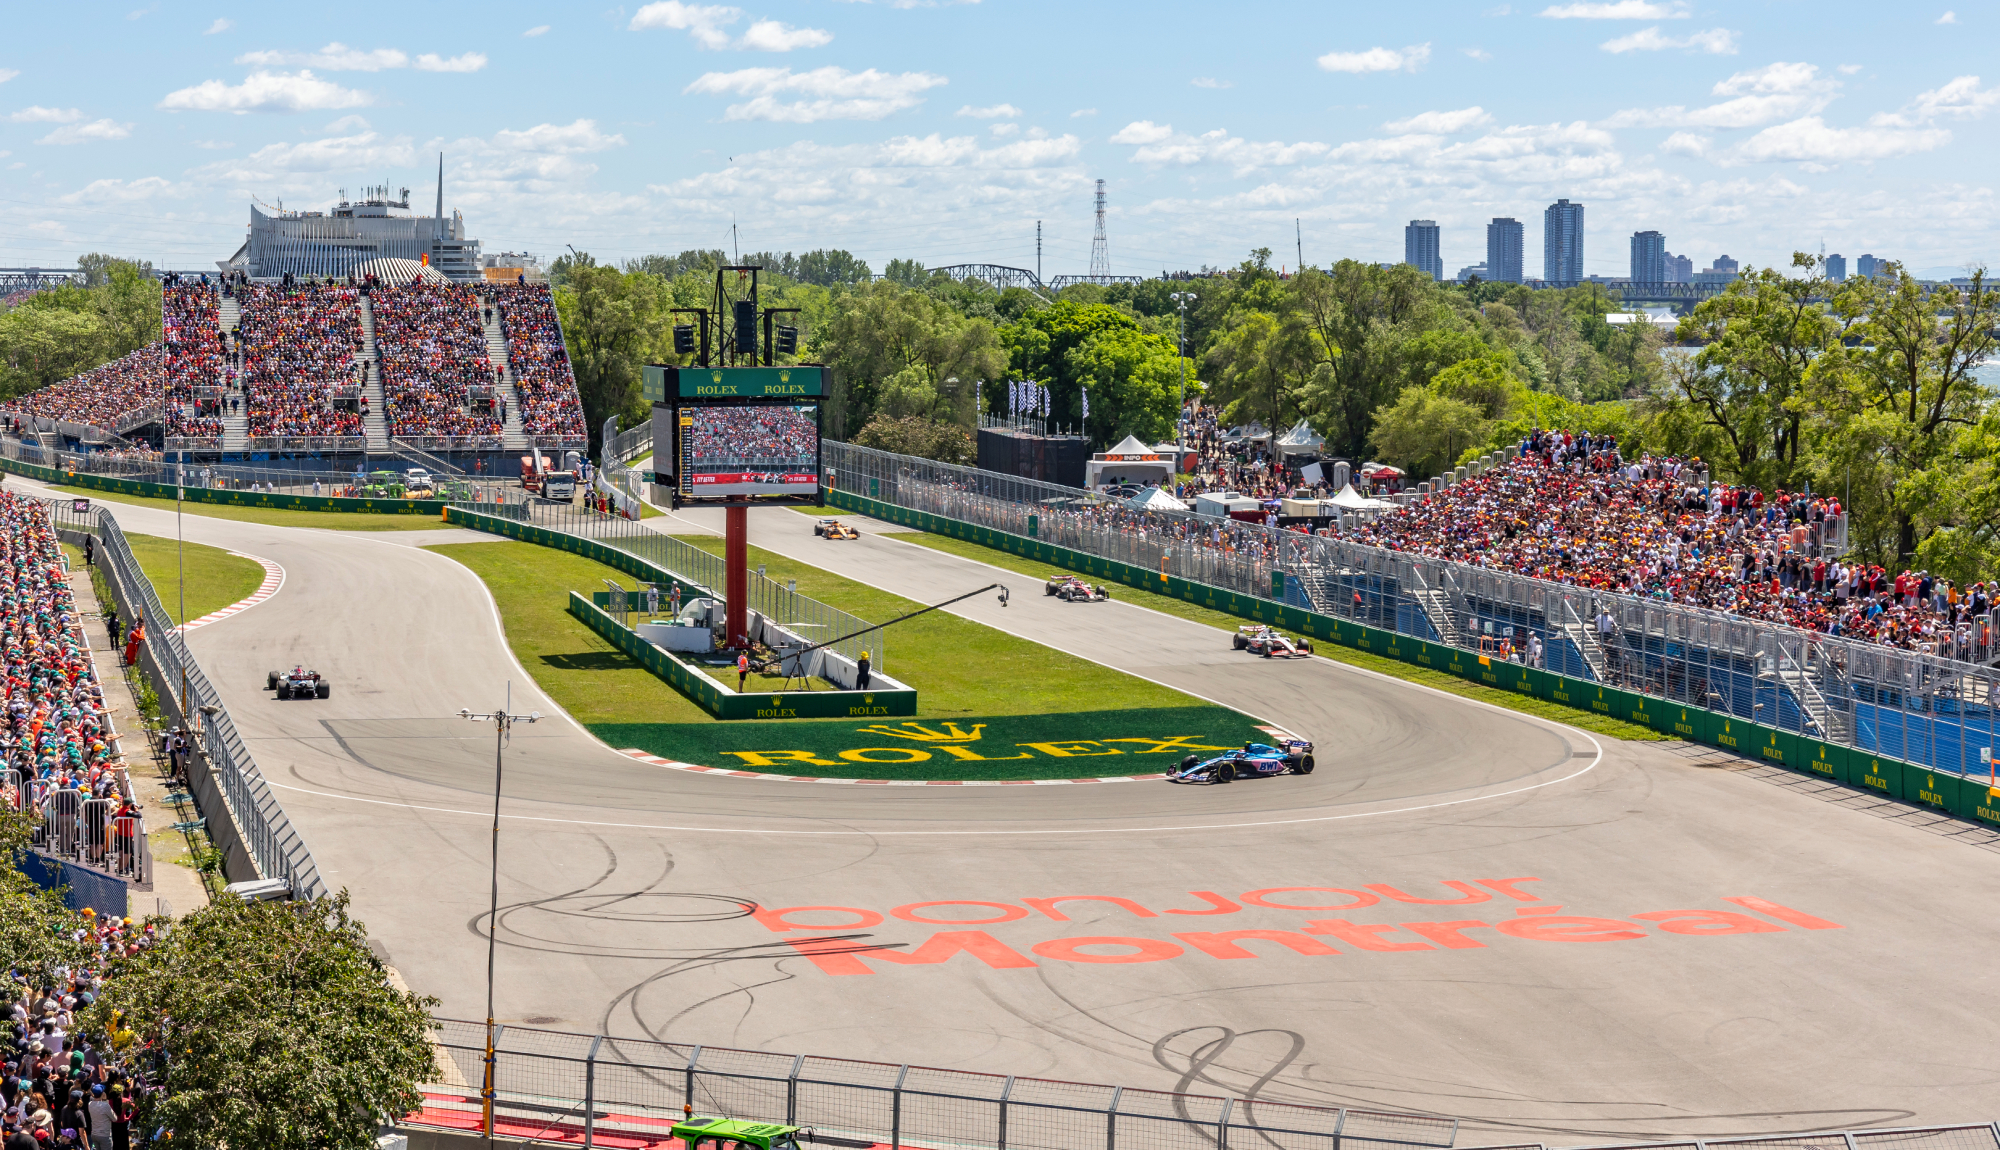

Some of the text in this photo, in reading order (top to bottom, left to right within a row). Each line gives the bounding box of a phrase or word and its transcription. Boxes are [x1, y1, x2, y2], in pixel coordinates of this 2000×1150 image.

[697, 386, 738, 394] ROLEX
[764, 385, 806, 394] ROLEX
[1330, 632, 1342, 641] ROLEX
[1358, 639, 1370, 648] ROLEX
[1388, 646, 1400, 656] ROLEX
[1418, 654, 1432, 664] ROLEX
[1449, 662, 1464, 674] ROLEX
[1482, 672, 1497, 683] ROLEX
[1517, 681, 1532, 692] ROLEX
[1553, 690, 1570, 702] ROLEX
[849, 706, 888, 716] ROLEX
[1592, 700, 1609, 712] ROLEX
[757, 708, 796, 717] ROLEX
[1632, 710, 1650, 724] ROLEX
[1675, 722, 1693, 735] ROLEX
[1718, 734, 1737, 748] ROLEX
[720, 736, 1246, 767] ROLEX
[1763, 746, 1783, 761] ROLEX
[1259, 760, 1278, 770] BWT
[1812, 760, 1834, 775] ROLEX
[1864, 774, 1888, 790] ROLEX
[1919, 789, 1943, 806] ROLEX
[1977, 806, 2000, 822] ROLEX
[736, 877, 1542, 932] bonjour
[782, 895, 1846, 976] Montréal
